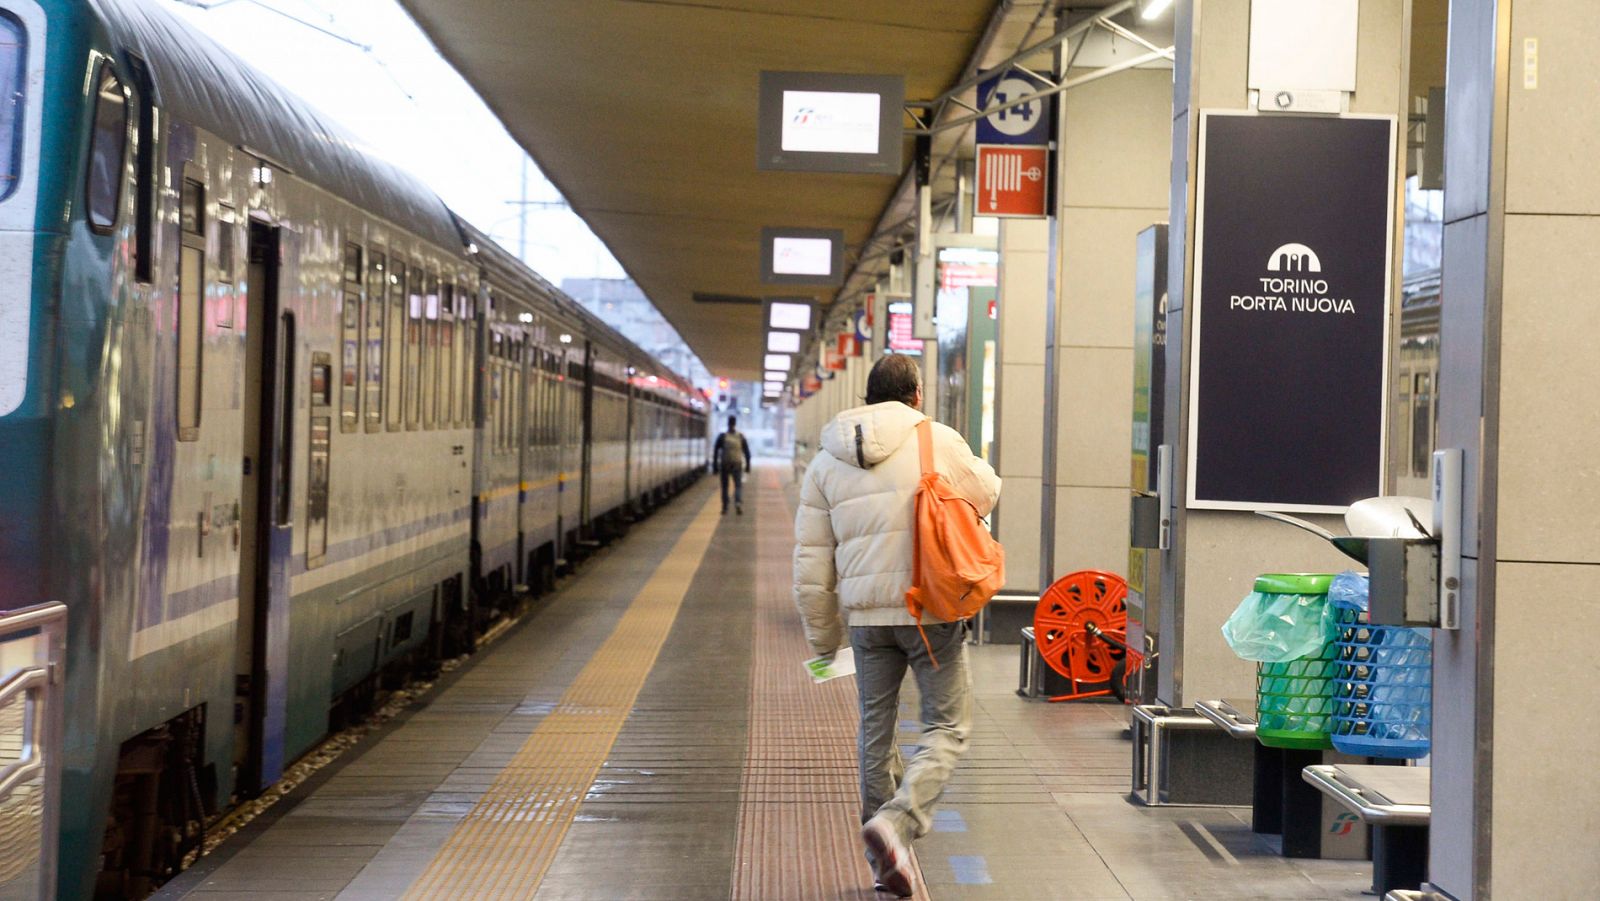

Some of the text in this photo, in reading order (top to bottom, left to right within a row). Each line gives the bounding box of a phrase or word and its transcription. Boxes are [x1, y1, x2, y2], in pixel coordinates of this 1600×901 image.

[995, 92, 1033, 121] 14
[1260, 278, 1328, 294] TORINO
[1230, 295, 1355, 314] PORTA NUOVA
